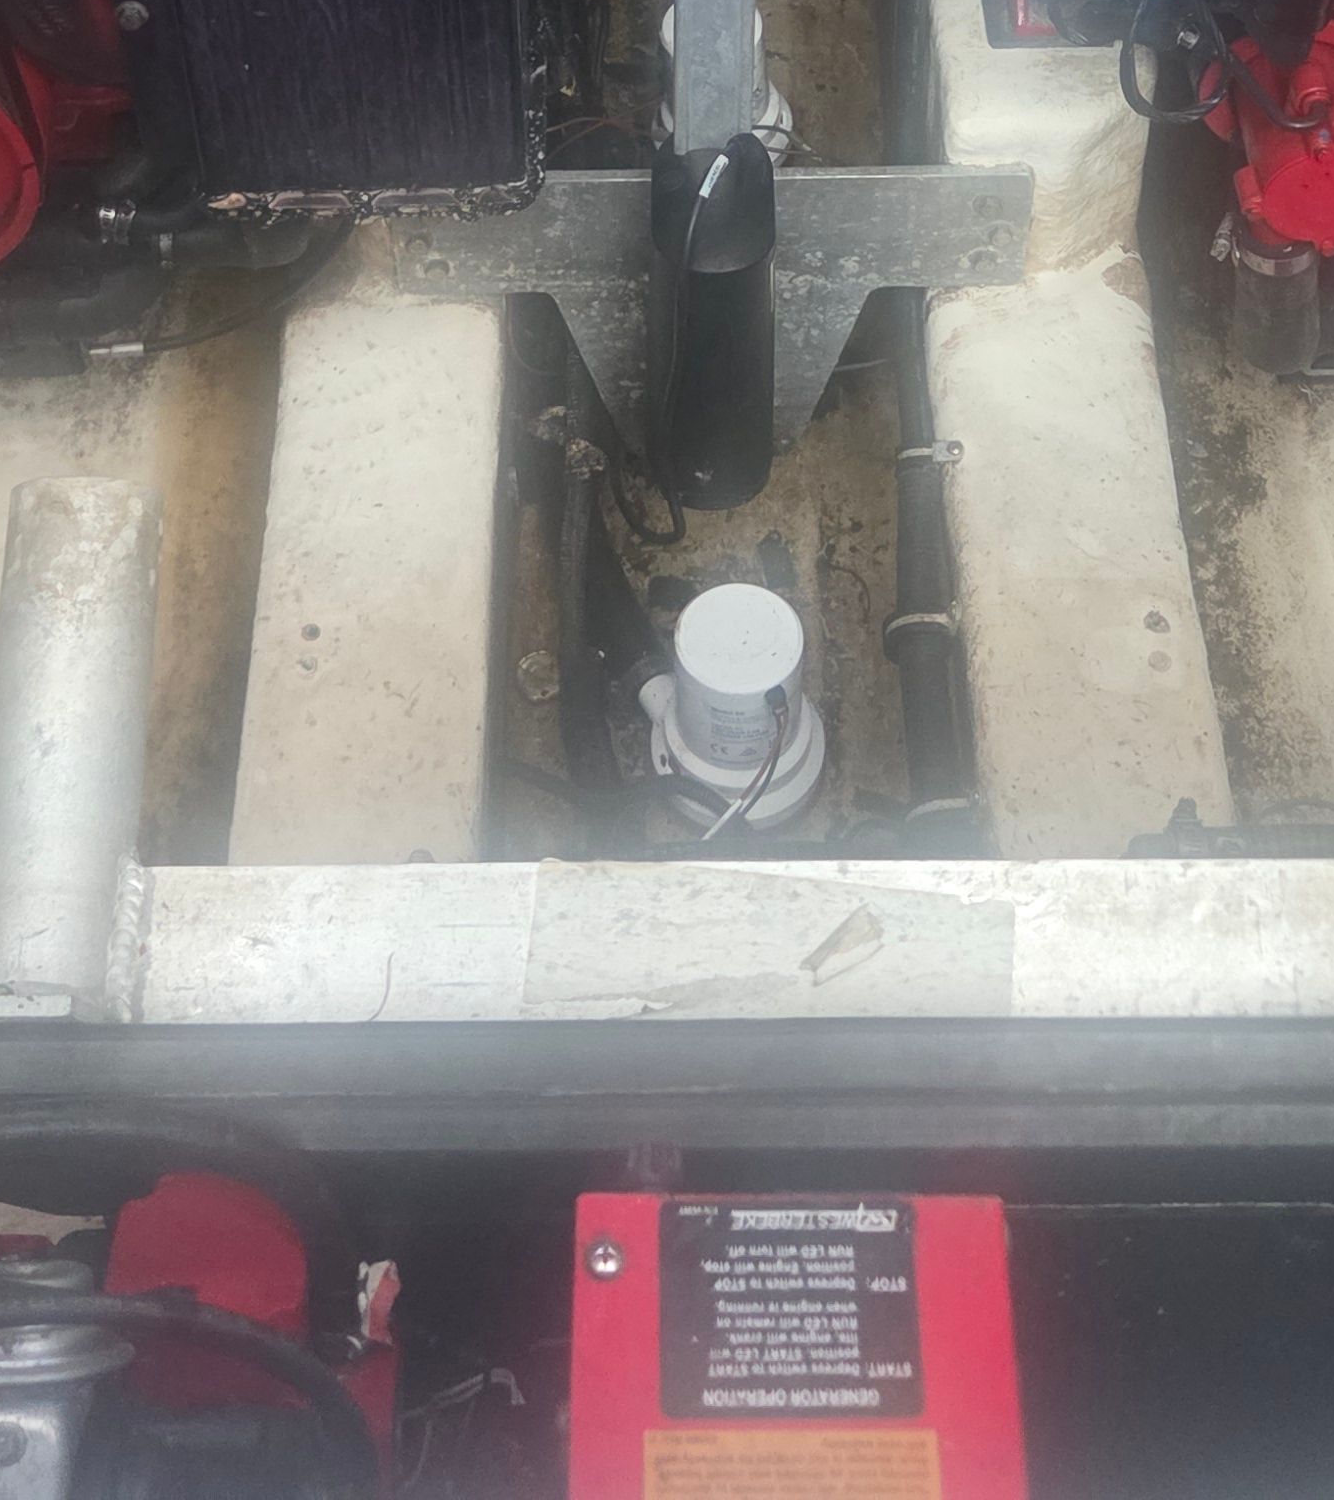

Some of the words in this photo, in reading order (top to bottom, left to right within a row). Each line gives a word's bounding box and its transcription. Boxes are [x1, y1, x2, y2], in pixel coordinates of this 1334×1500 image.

[713, 1277, 746, 1292] STOP
[766, 1277, 803, 1292] switch
[807, 1275, 857, 1292] Depress
[763, 1347, 802, 1360] START
[708, 1362, 749, 1377] START
[769, 1362, 807, 1377] switch
[811, 1361, 860, 1377] Depress
[702, 1387, 787, 1407] OPERATION
[790, 1387, 880, 1407] GENERATOR
